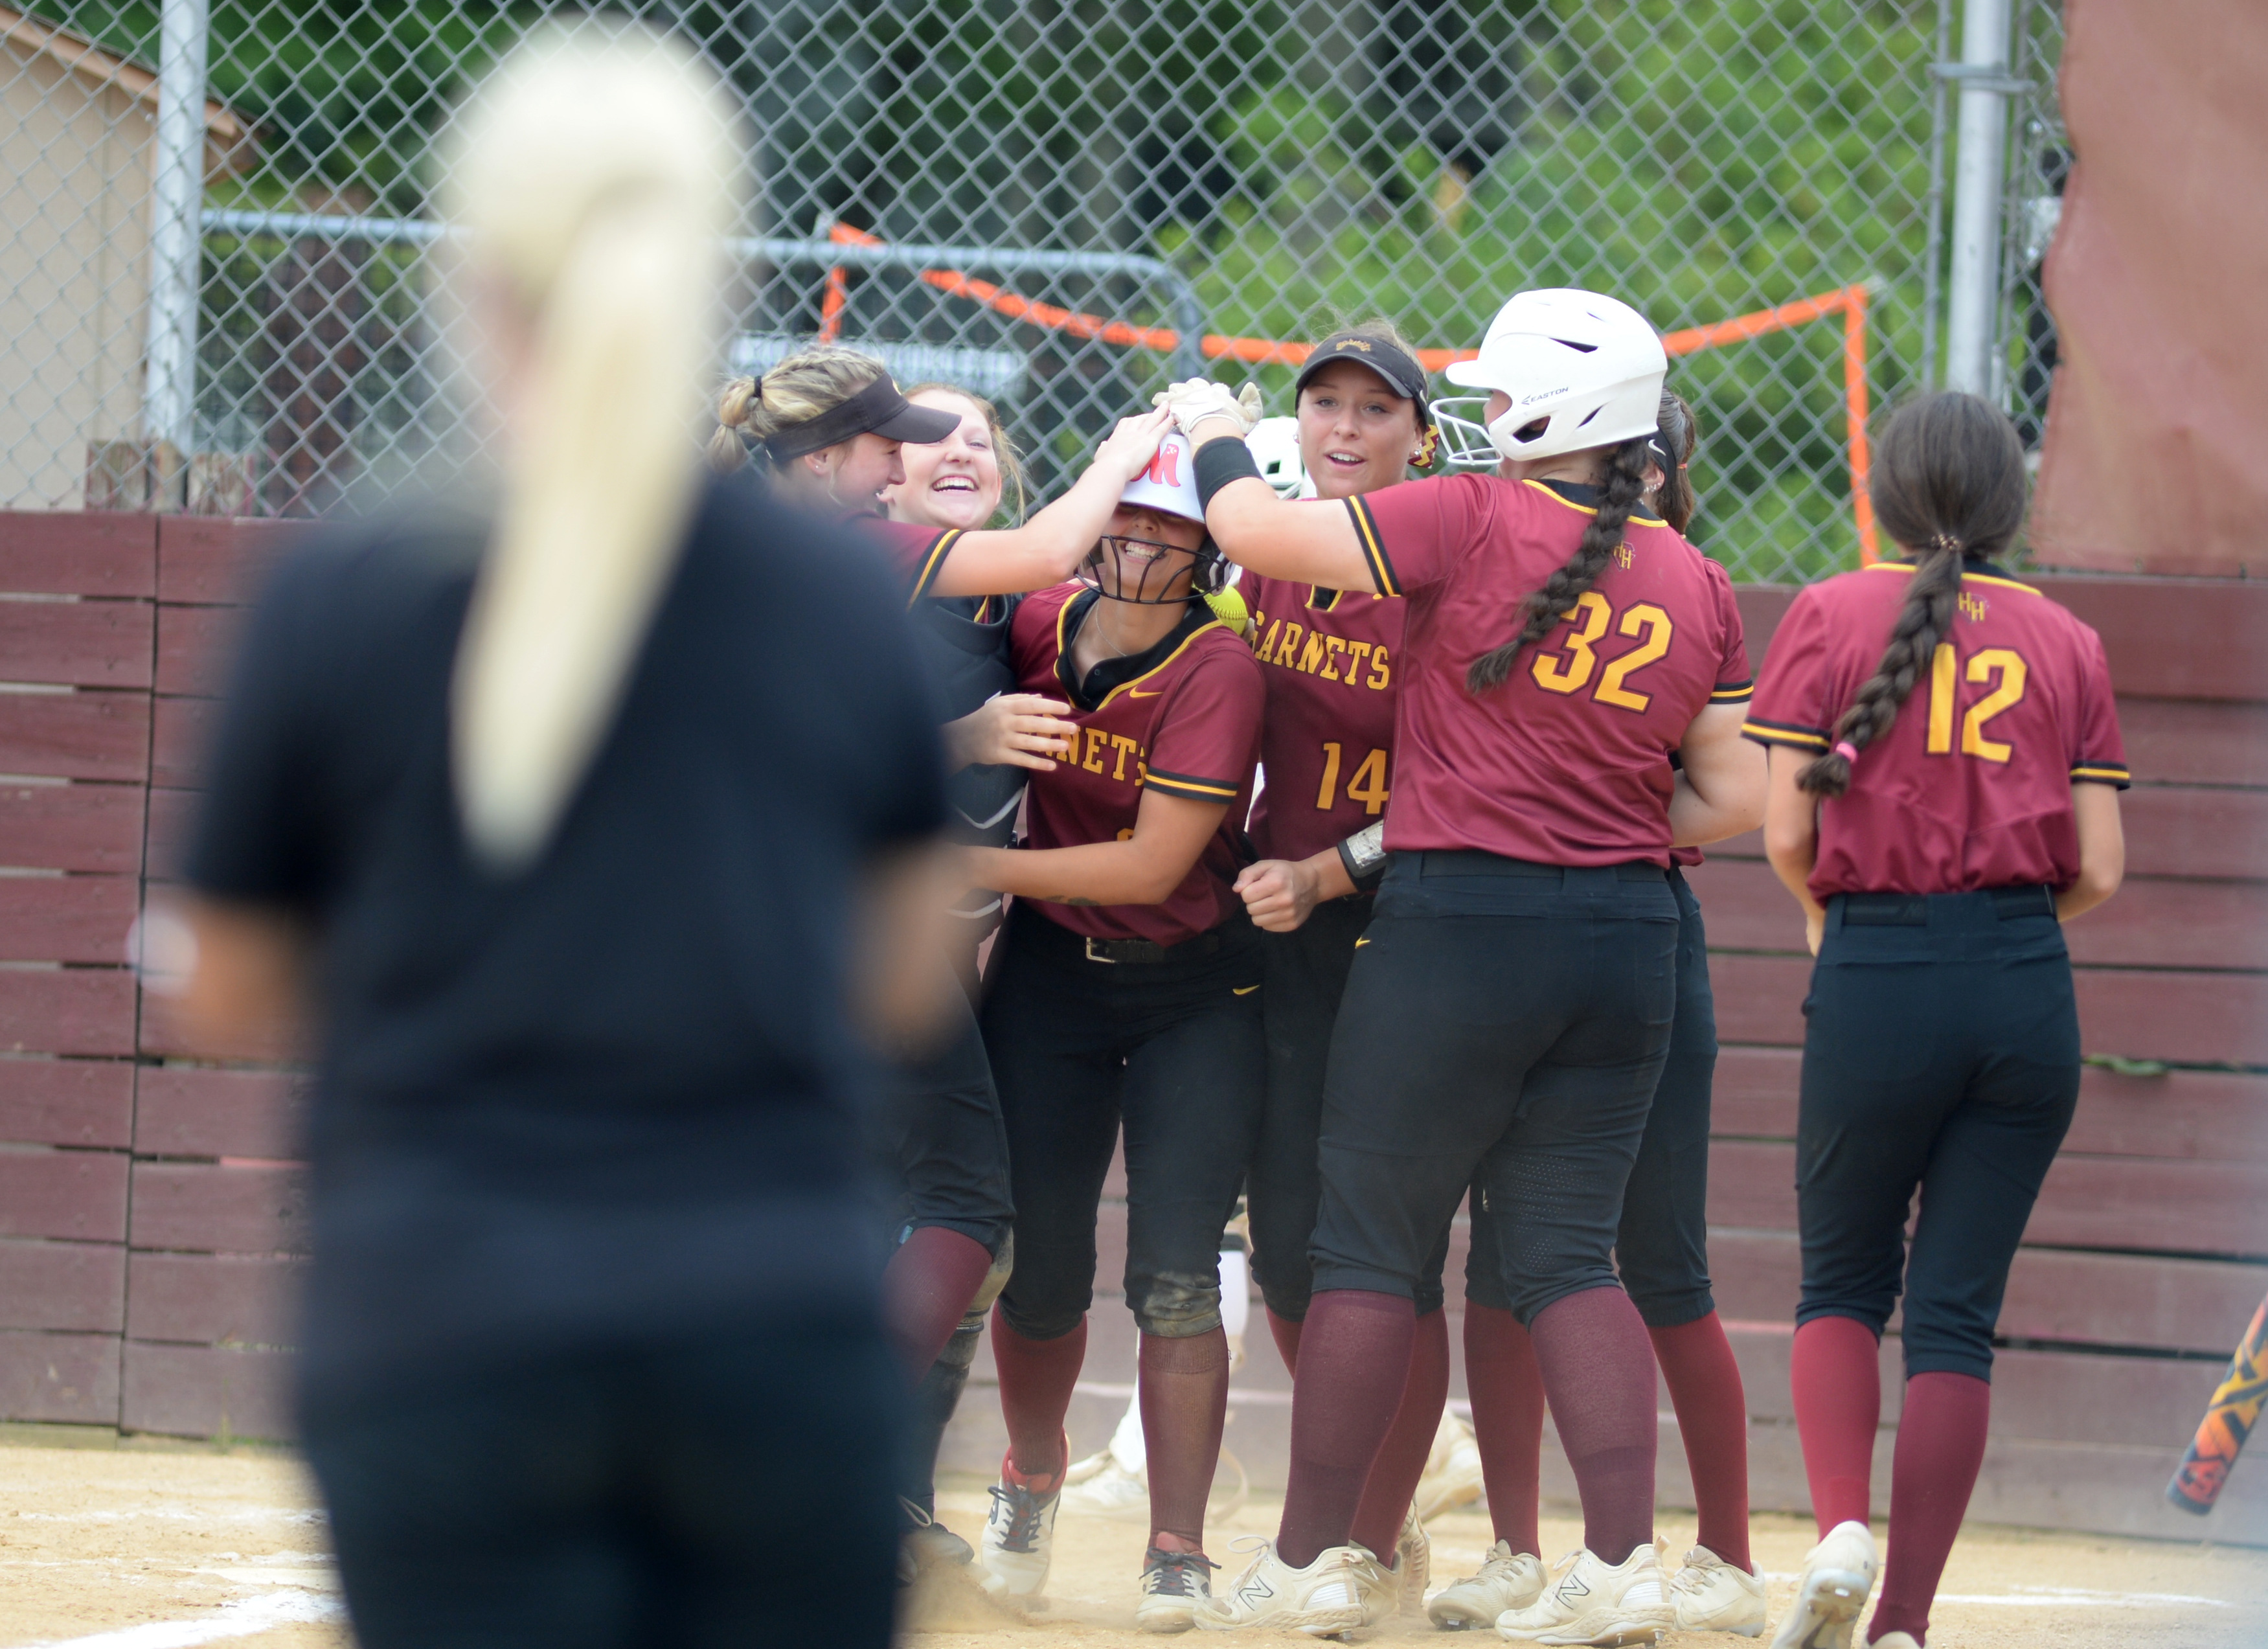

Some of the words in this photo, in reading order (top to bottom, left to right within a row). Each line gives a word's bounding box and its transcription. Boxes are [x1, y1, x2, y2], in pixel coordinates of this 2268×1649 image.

[1530, 387, 1569, 402] EASTON
[1958, 591, 1985, 621] HH
[1529, 589, 1673, 714] 32
[1925, 643, 2028, 766] 12
[1317, 742, 1390, 815] 14
